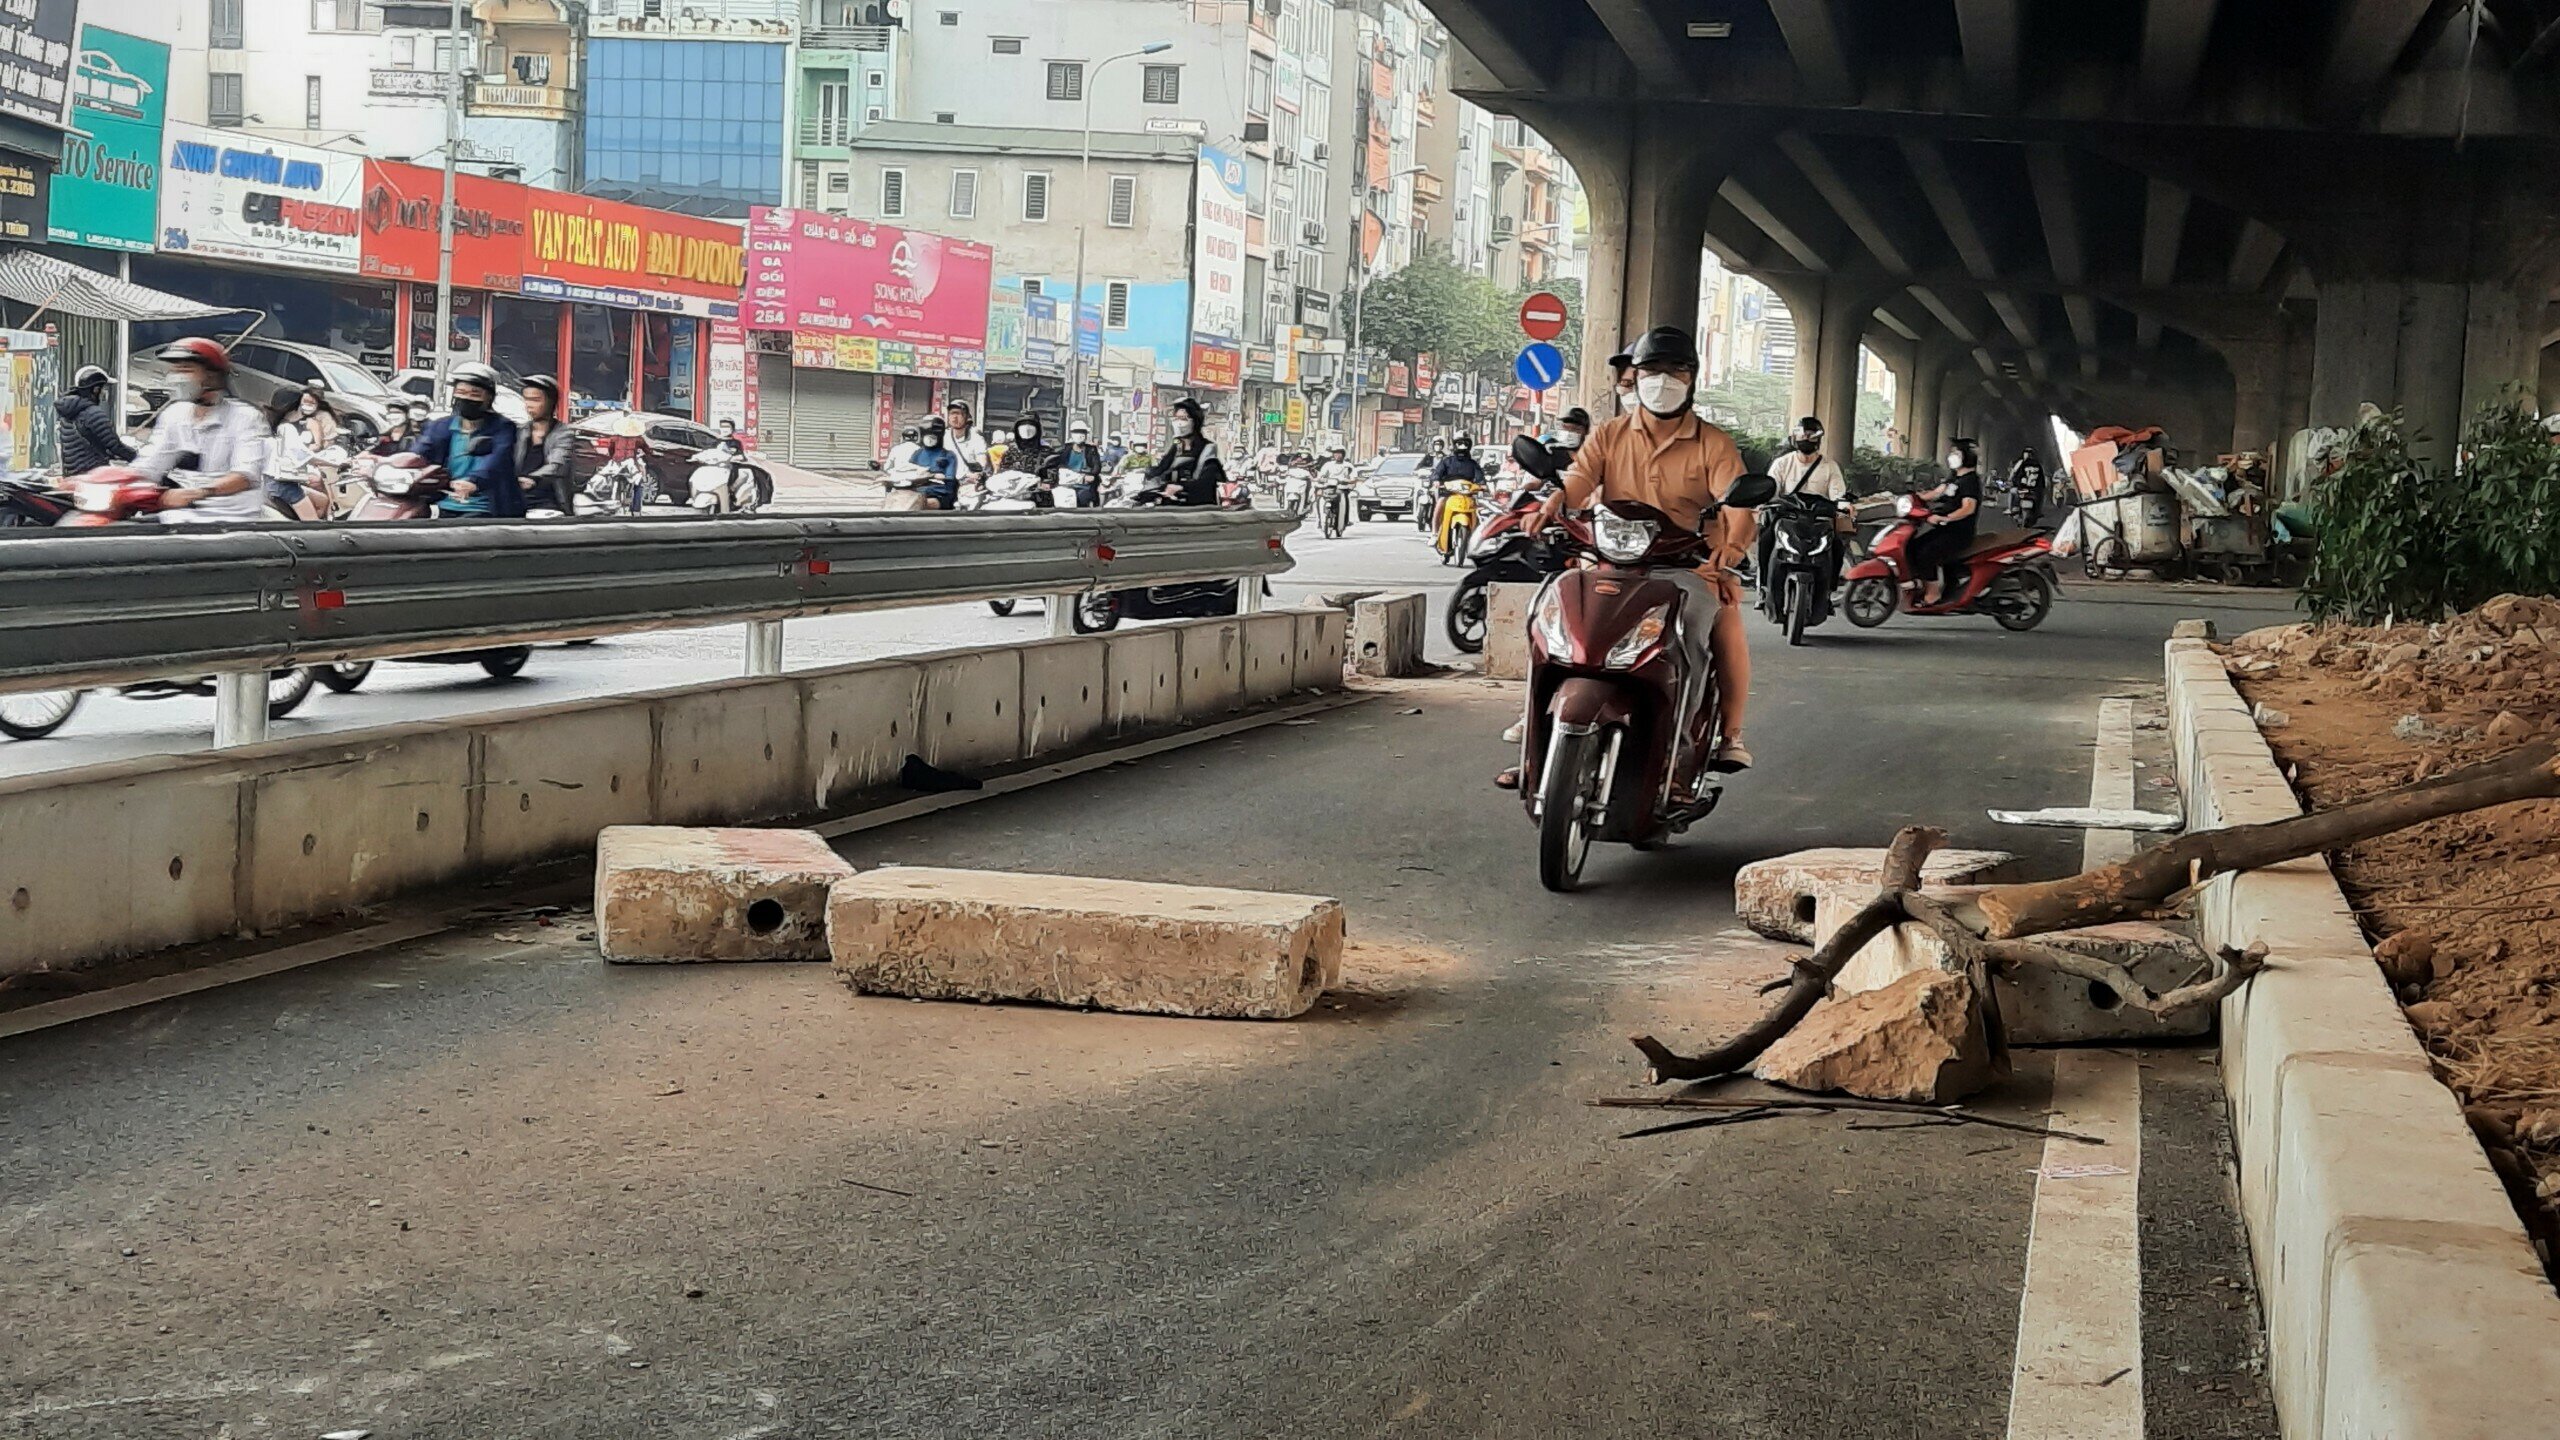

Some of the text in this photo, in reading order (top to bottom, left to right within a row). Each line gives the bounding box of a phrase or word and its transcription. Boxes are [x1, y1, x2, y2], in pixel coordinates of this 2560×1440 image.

[94, 144, 153, 190] Service
[533, 204, 640, 273] VẠN PHÁT AUTO
